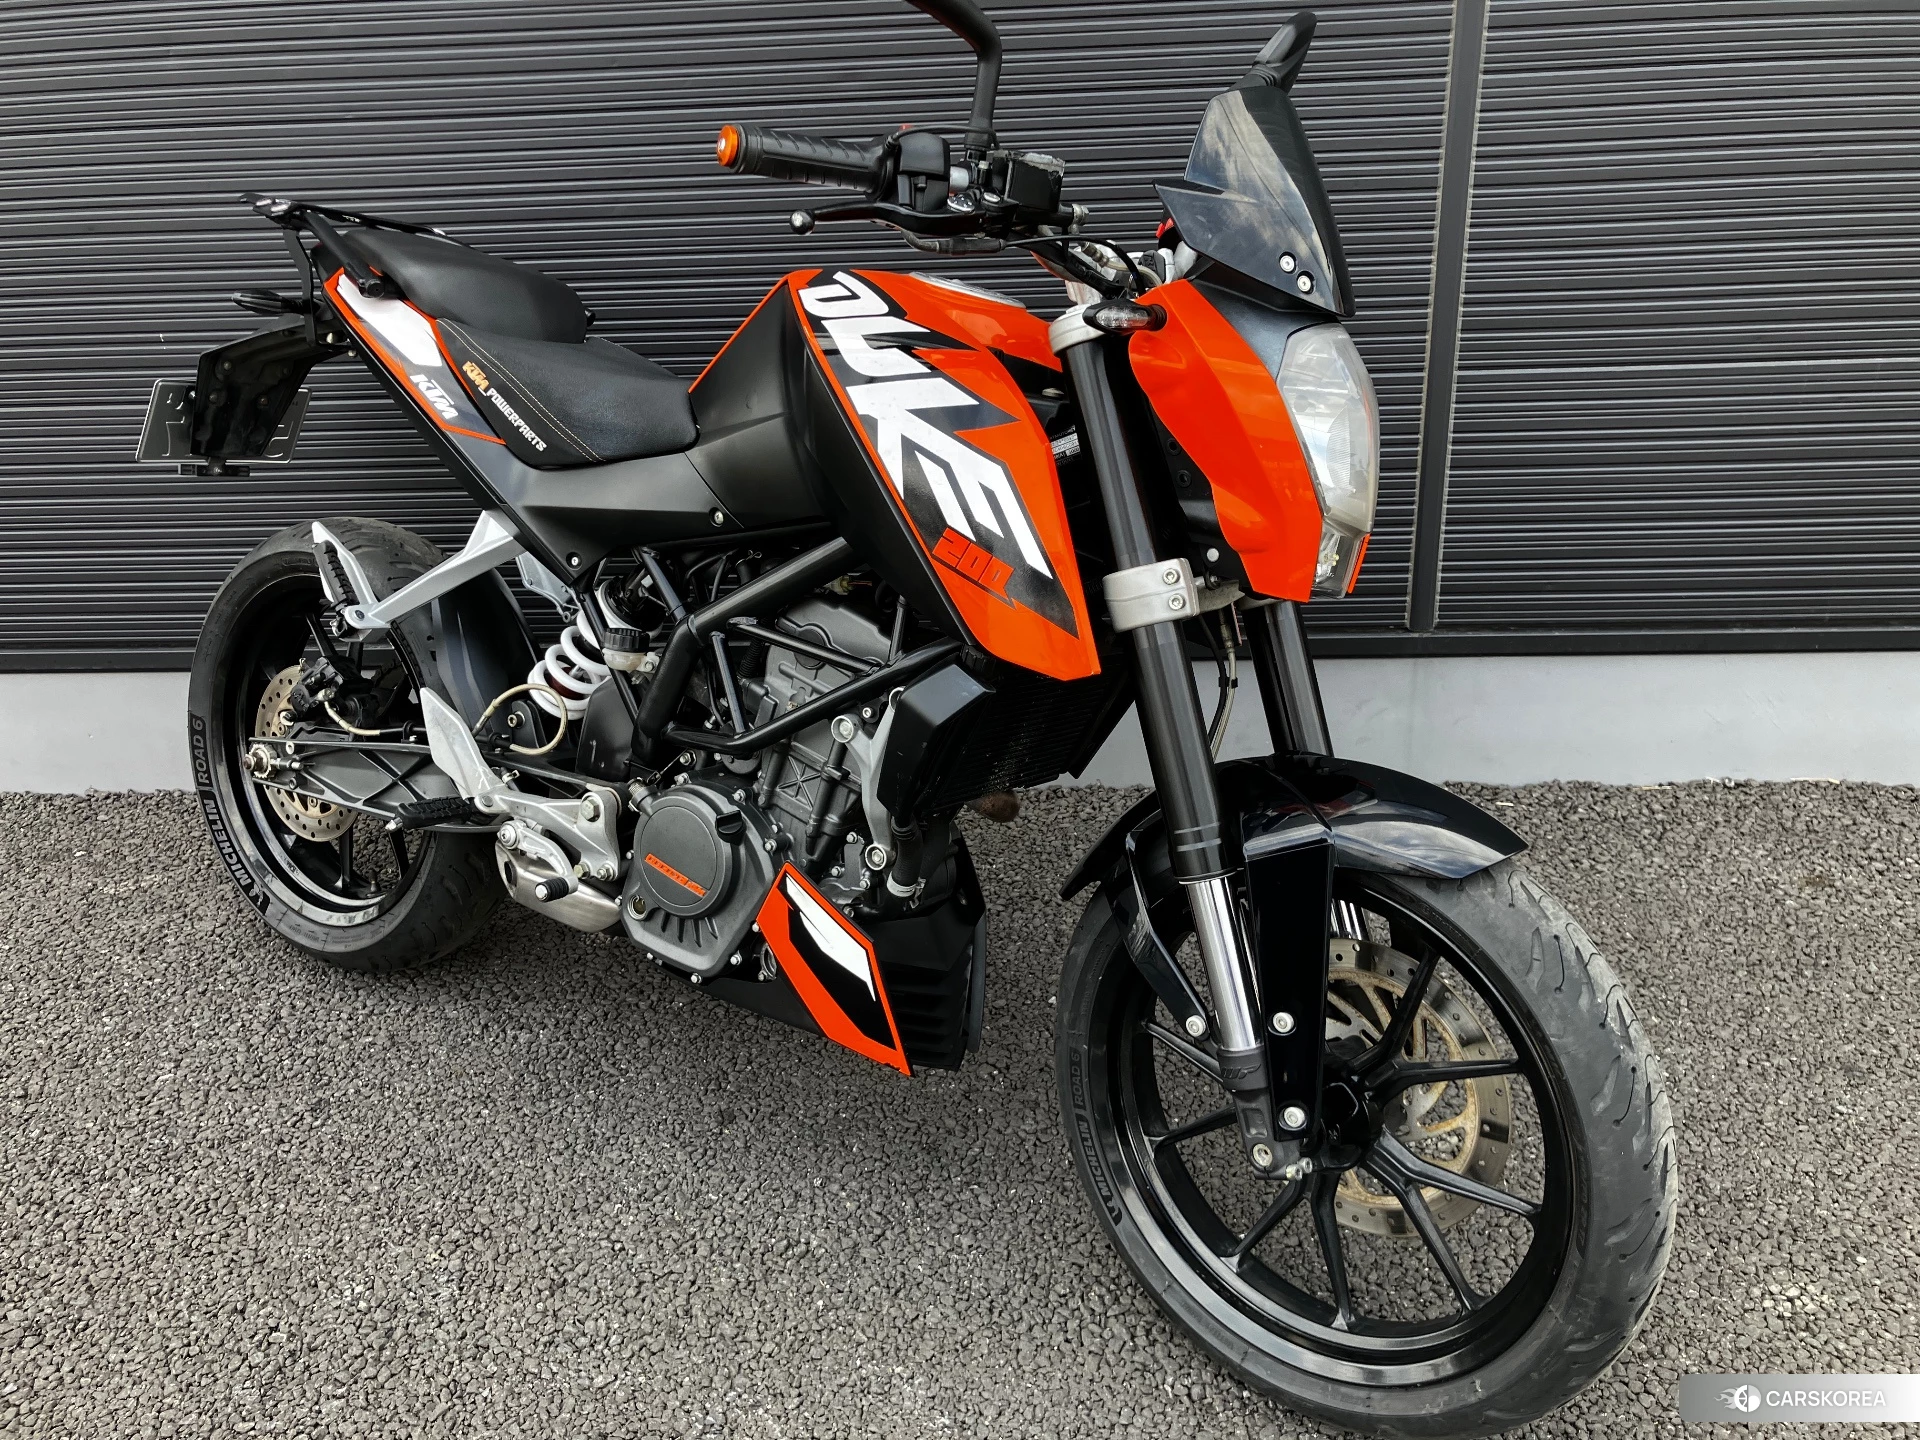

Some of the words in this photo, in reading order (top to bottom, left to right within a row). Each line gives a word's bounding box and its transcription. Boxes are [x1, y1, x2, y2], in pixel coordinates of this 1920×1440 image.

[409, 374, 459, 420] KTM
[462, 361, 490, 391] KTM
[798, 271, 1054, 580] DUKE
[931, 528, 1015, 601] 200
[193, 720, 204, 731] 6
[193, 735, 210, 784] ROAD
[203, 799, 252, 887] MICHELIN
[1071, 1052, 1081, 1061] 6
[1071, 1067, 1085, 1106] ROAD
[1078, 1121, 1112, 1197] MICHELIN
